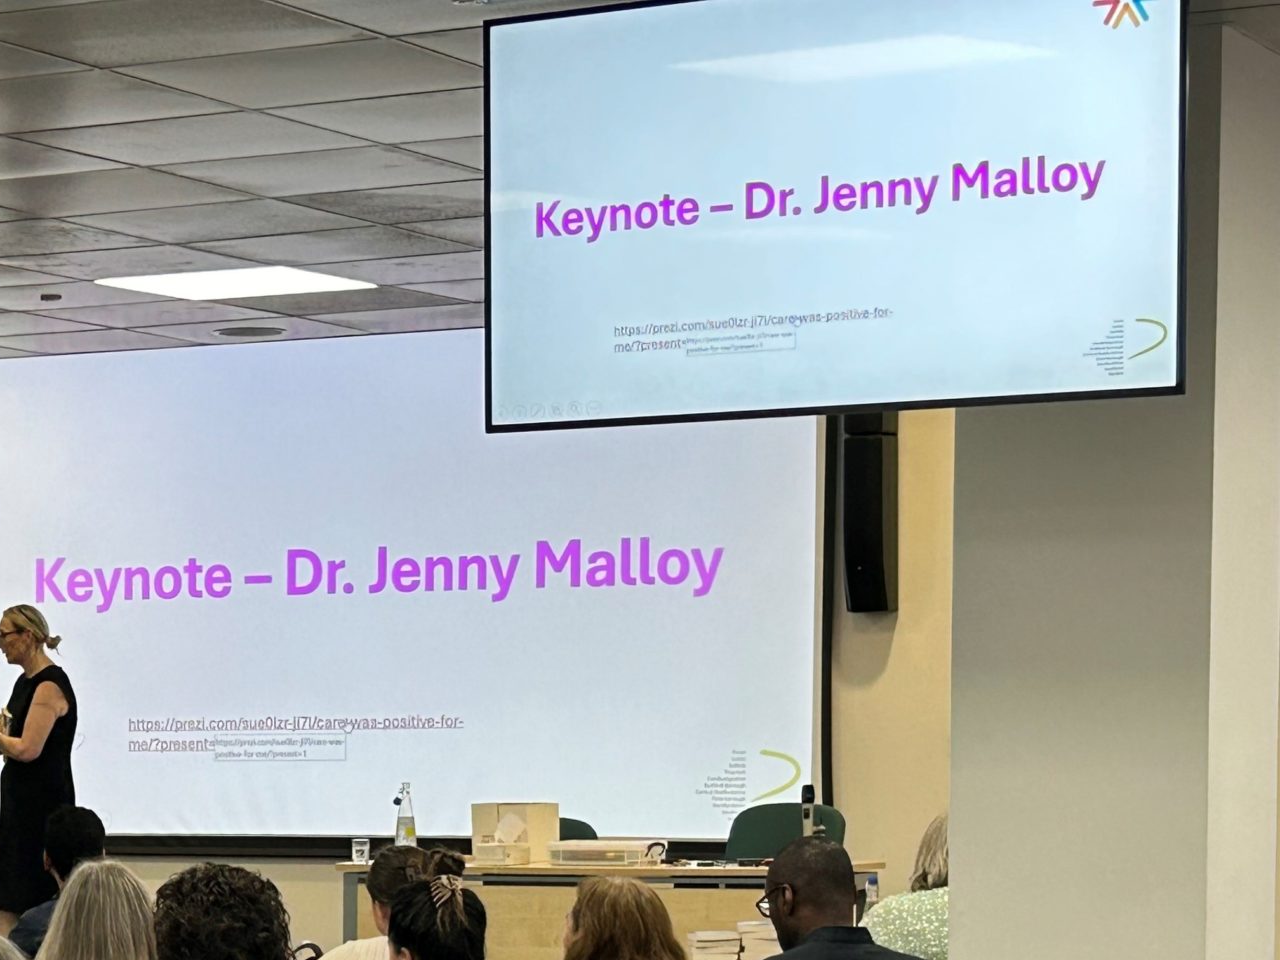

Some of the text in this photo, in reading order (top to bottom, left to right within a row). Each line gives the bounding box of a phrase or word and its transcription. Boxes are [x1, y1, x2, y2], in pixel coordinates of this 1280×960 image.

[535, 194, 700, 242] Keynote
[745, 181, 801, 220] Dr.
[814, 176, 938, 214] Jenny
[951, 156, 1105, 200] Malloy
[35, 557, 233, 613] Keynote
[286, 548, 354, 597] Dr.
[366, 545, 521, 603] Jenny
[535, 536, 724, 597] Malloy
